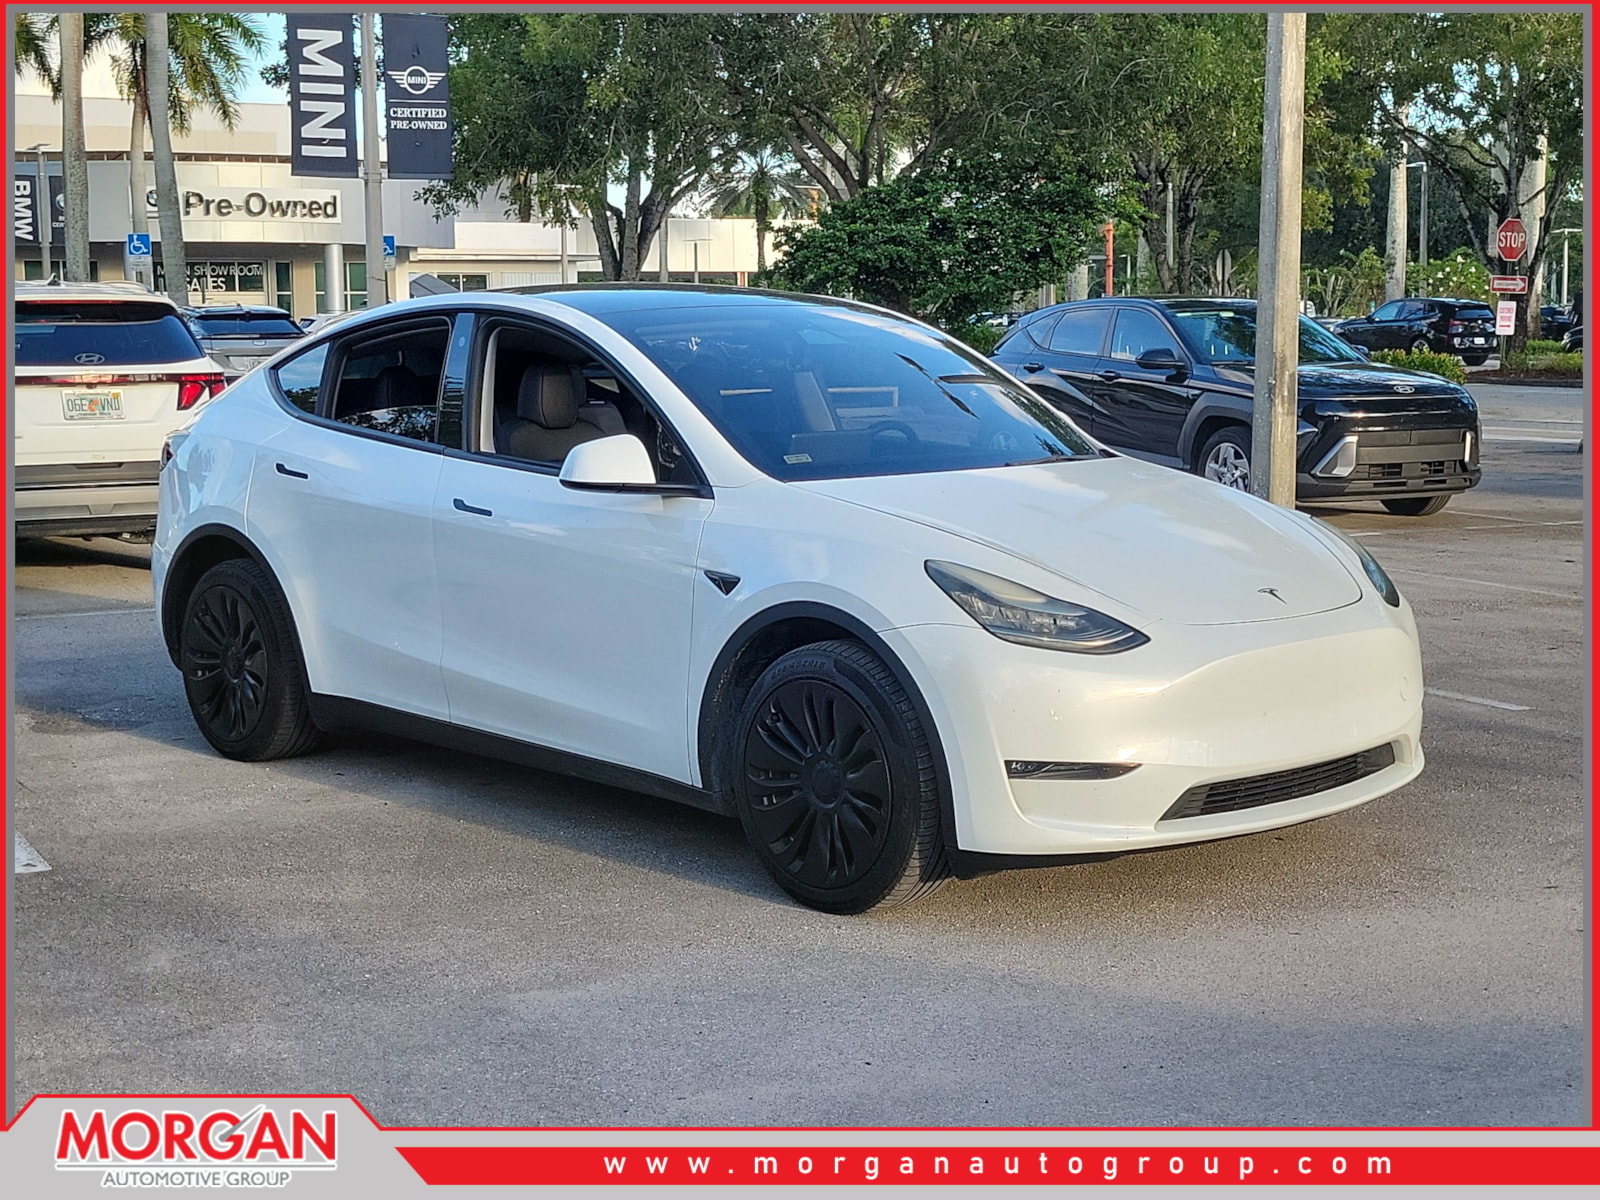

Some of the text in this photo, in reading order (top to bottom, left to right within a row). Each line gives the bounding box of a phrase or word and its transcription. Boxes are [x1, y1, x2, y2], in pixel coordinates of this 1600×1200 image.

[407, 76, 427, 84] MINI
[297, 28, 347, 158] MINI
[390, 107, 447, 118] CERTIFIED
[390, 120, 447, 130] PRE-OWNED
[14, 180, 34, 241] BMW
[183, 190, 338, 218] Pre-Owned
[1499, 232, 1525, 247] STOP
[157, 264, 263, 277] MN SHOWROOM
